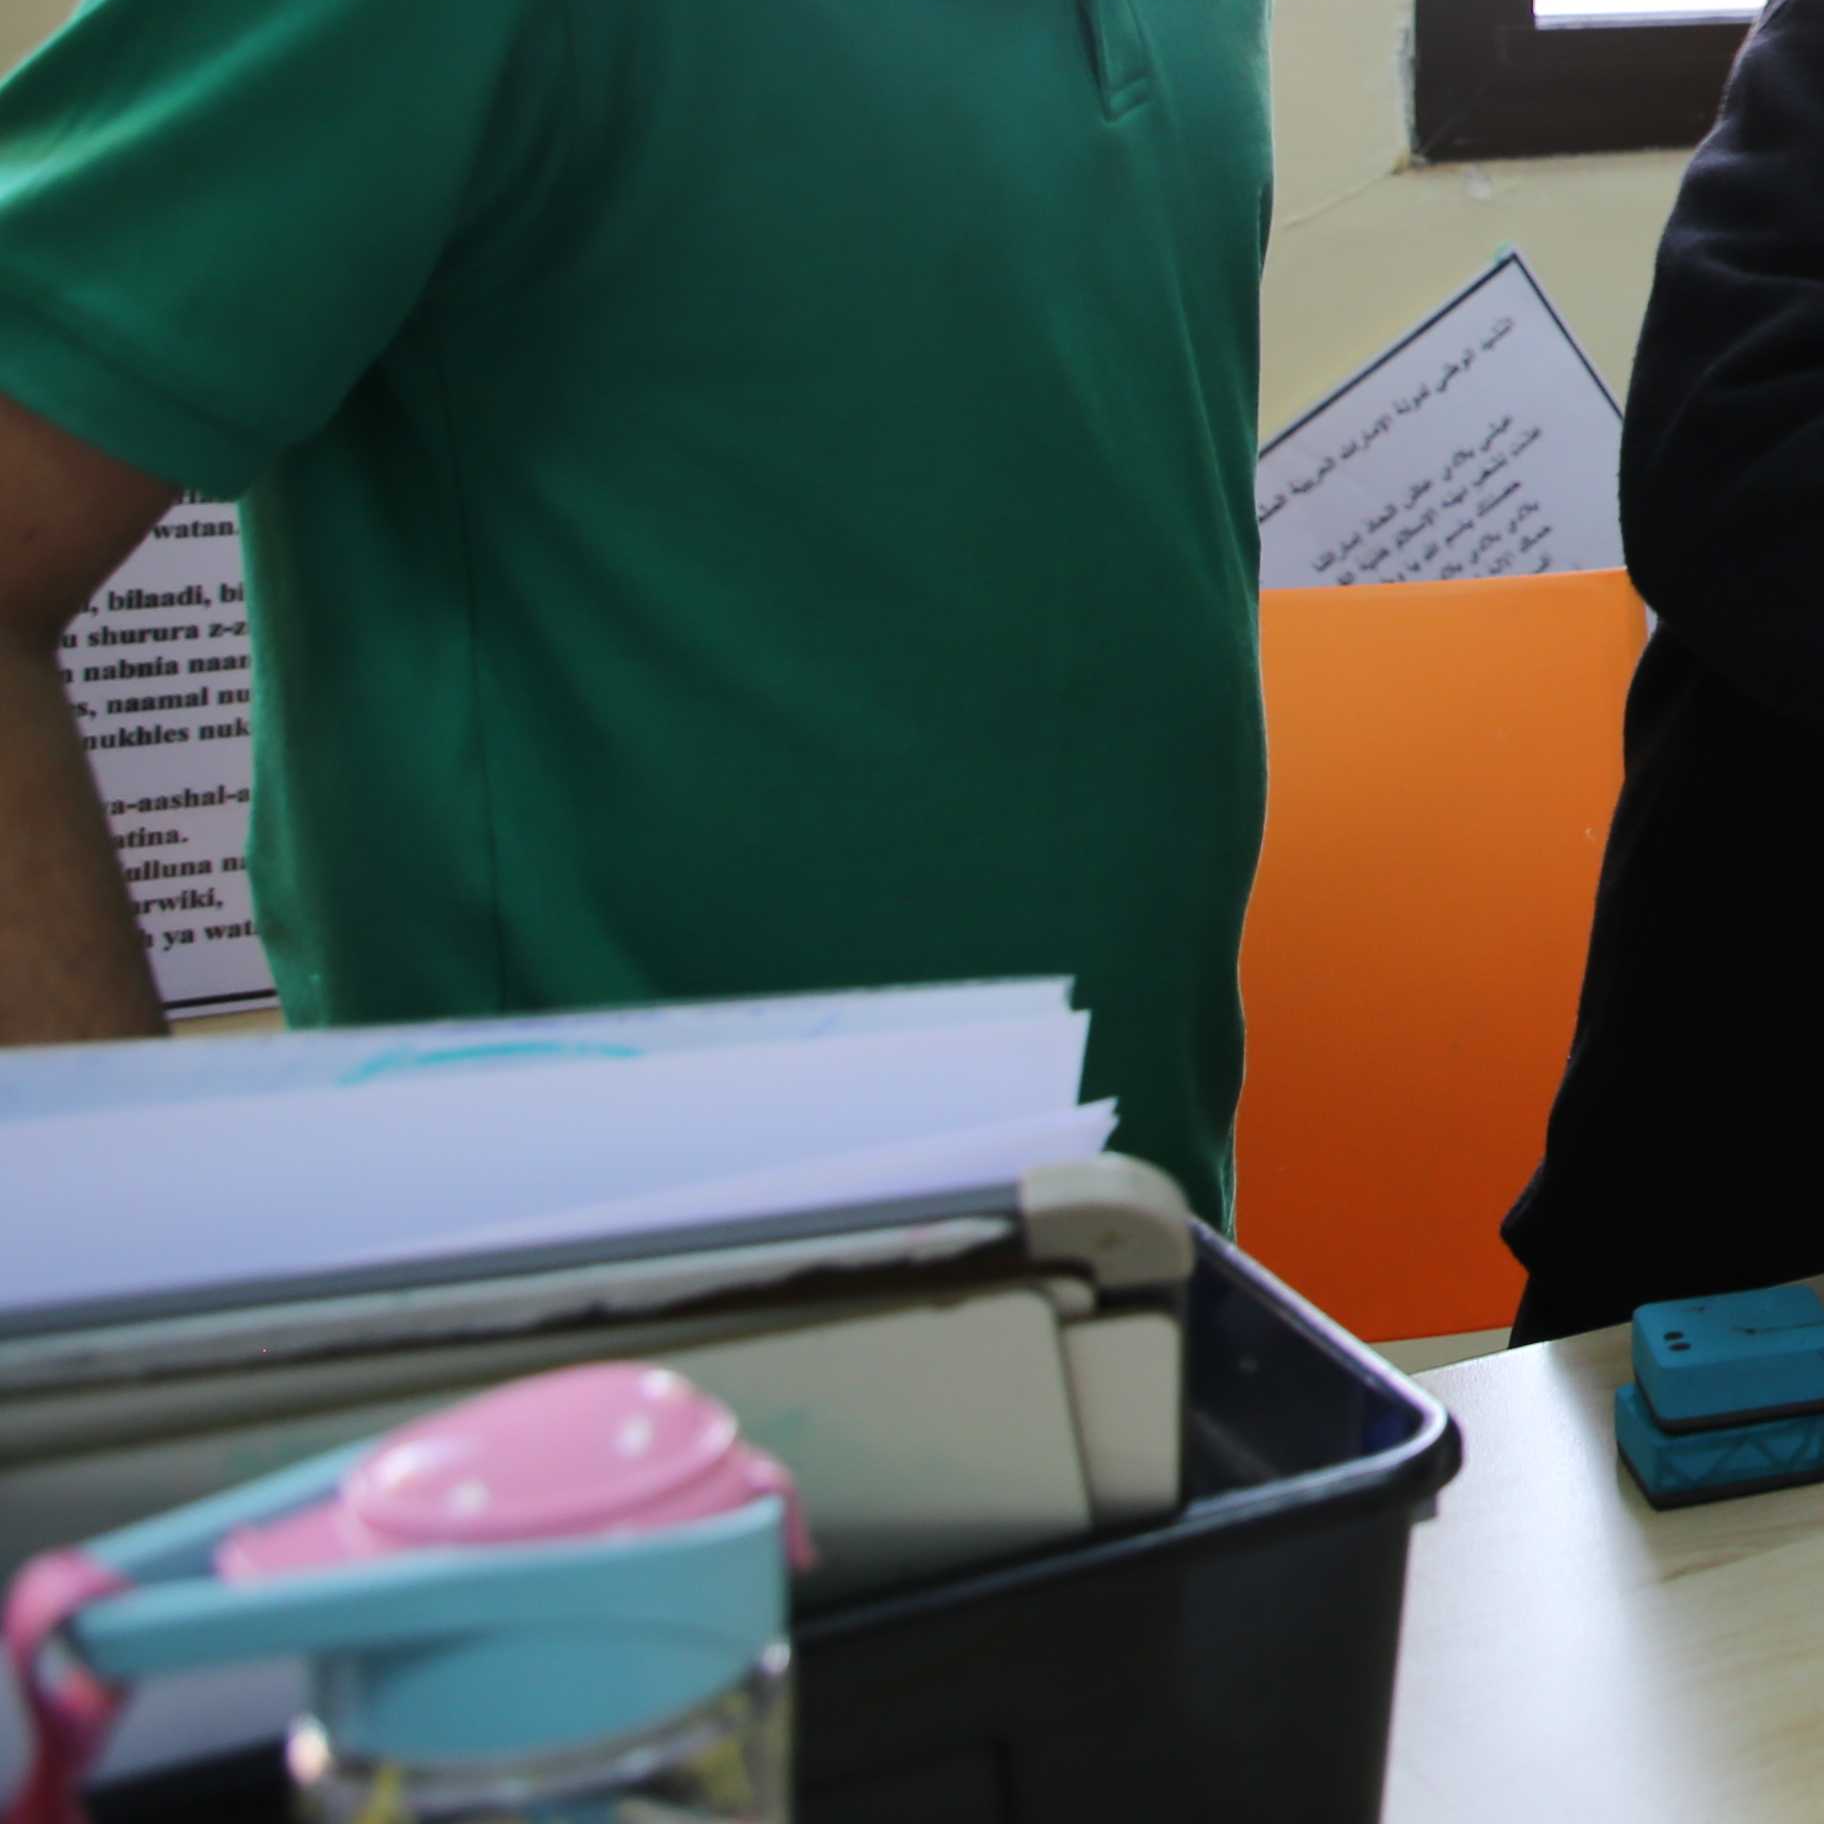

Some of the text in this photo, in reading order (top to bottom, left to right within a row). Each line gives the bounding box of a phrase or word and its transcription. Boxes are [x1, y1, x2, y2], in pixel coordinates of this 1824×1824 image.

[108, 584, 212, 611] bilaadi,
[88, 624, 199, 647] shurura
[107, 686, 209, 715] naamal
[163, 928, 195, 952] ya
